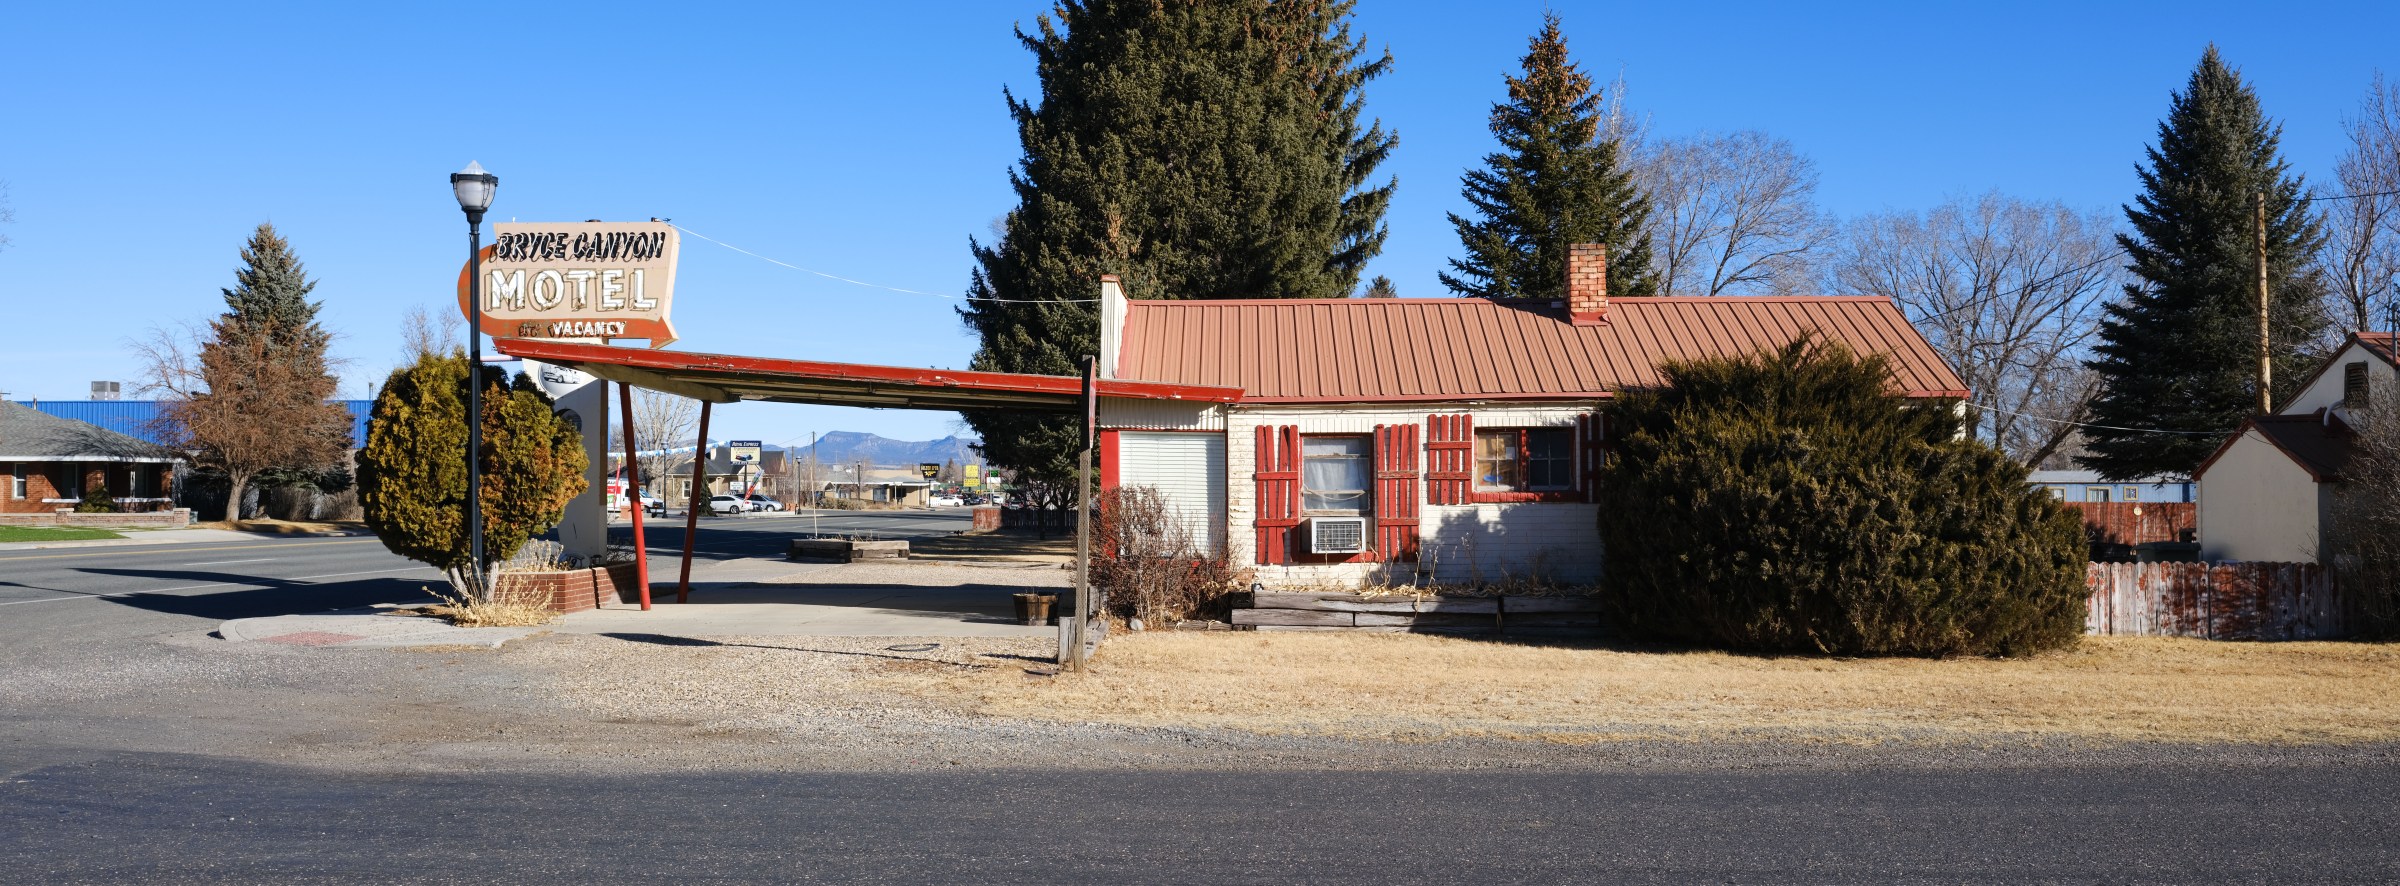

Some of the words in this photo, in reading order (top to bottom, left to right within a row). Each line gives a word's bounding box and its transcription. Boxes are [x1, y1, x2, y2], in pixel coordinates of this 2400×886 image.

[498, 232, 568, 260] BRYCE
[573, 231, 666, 260] CANYON
[490, 268, 659, 309] MOTEL
[552, 321, 626, 336] VACANCY
